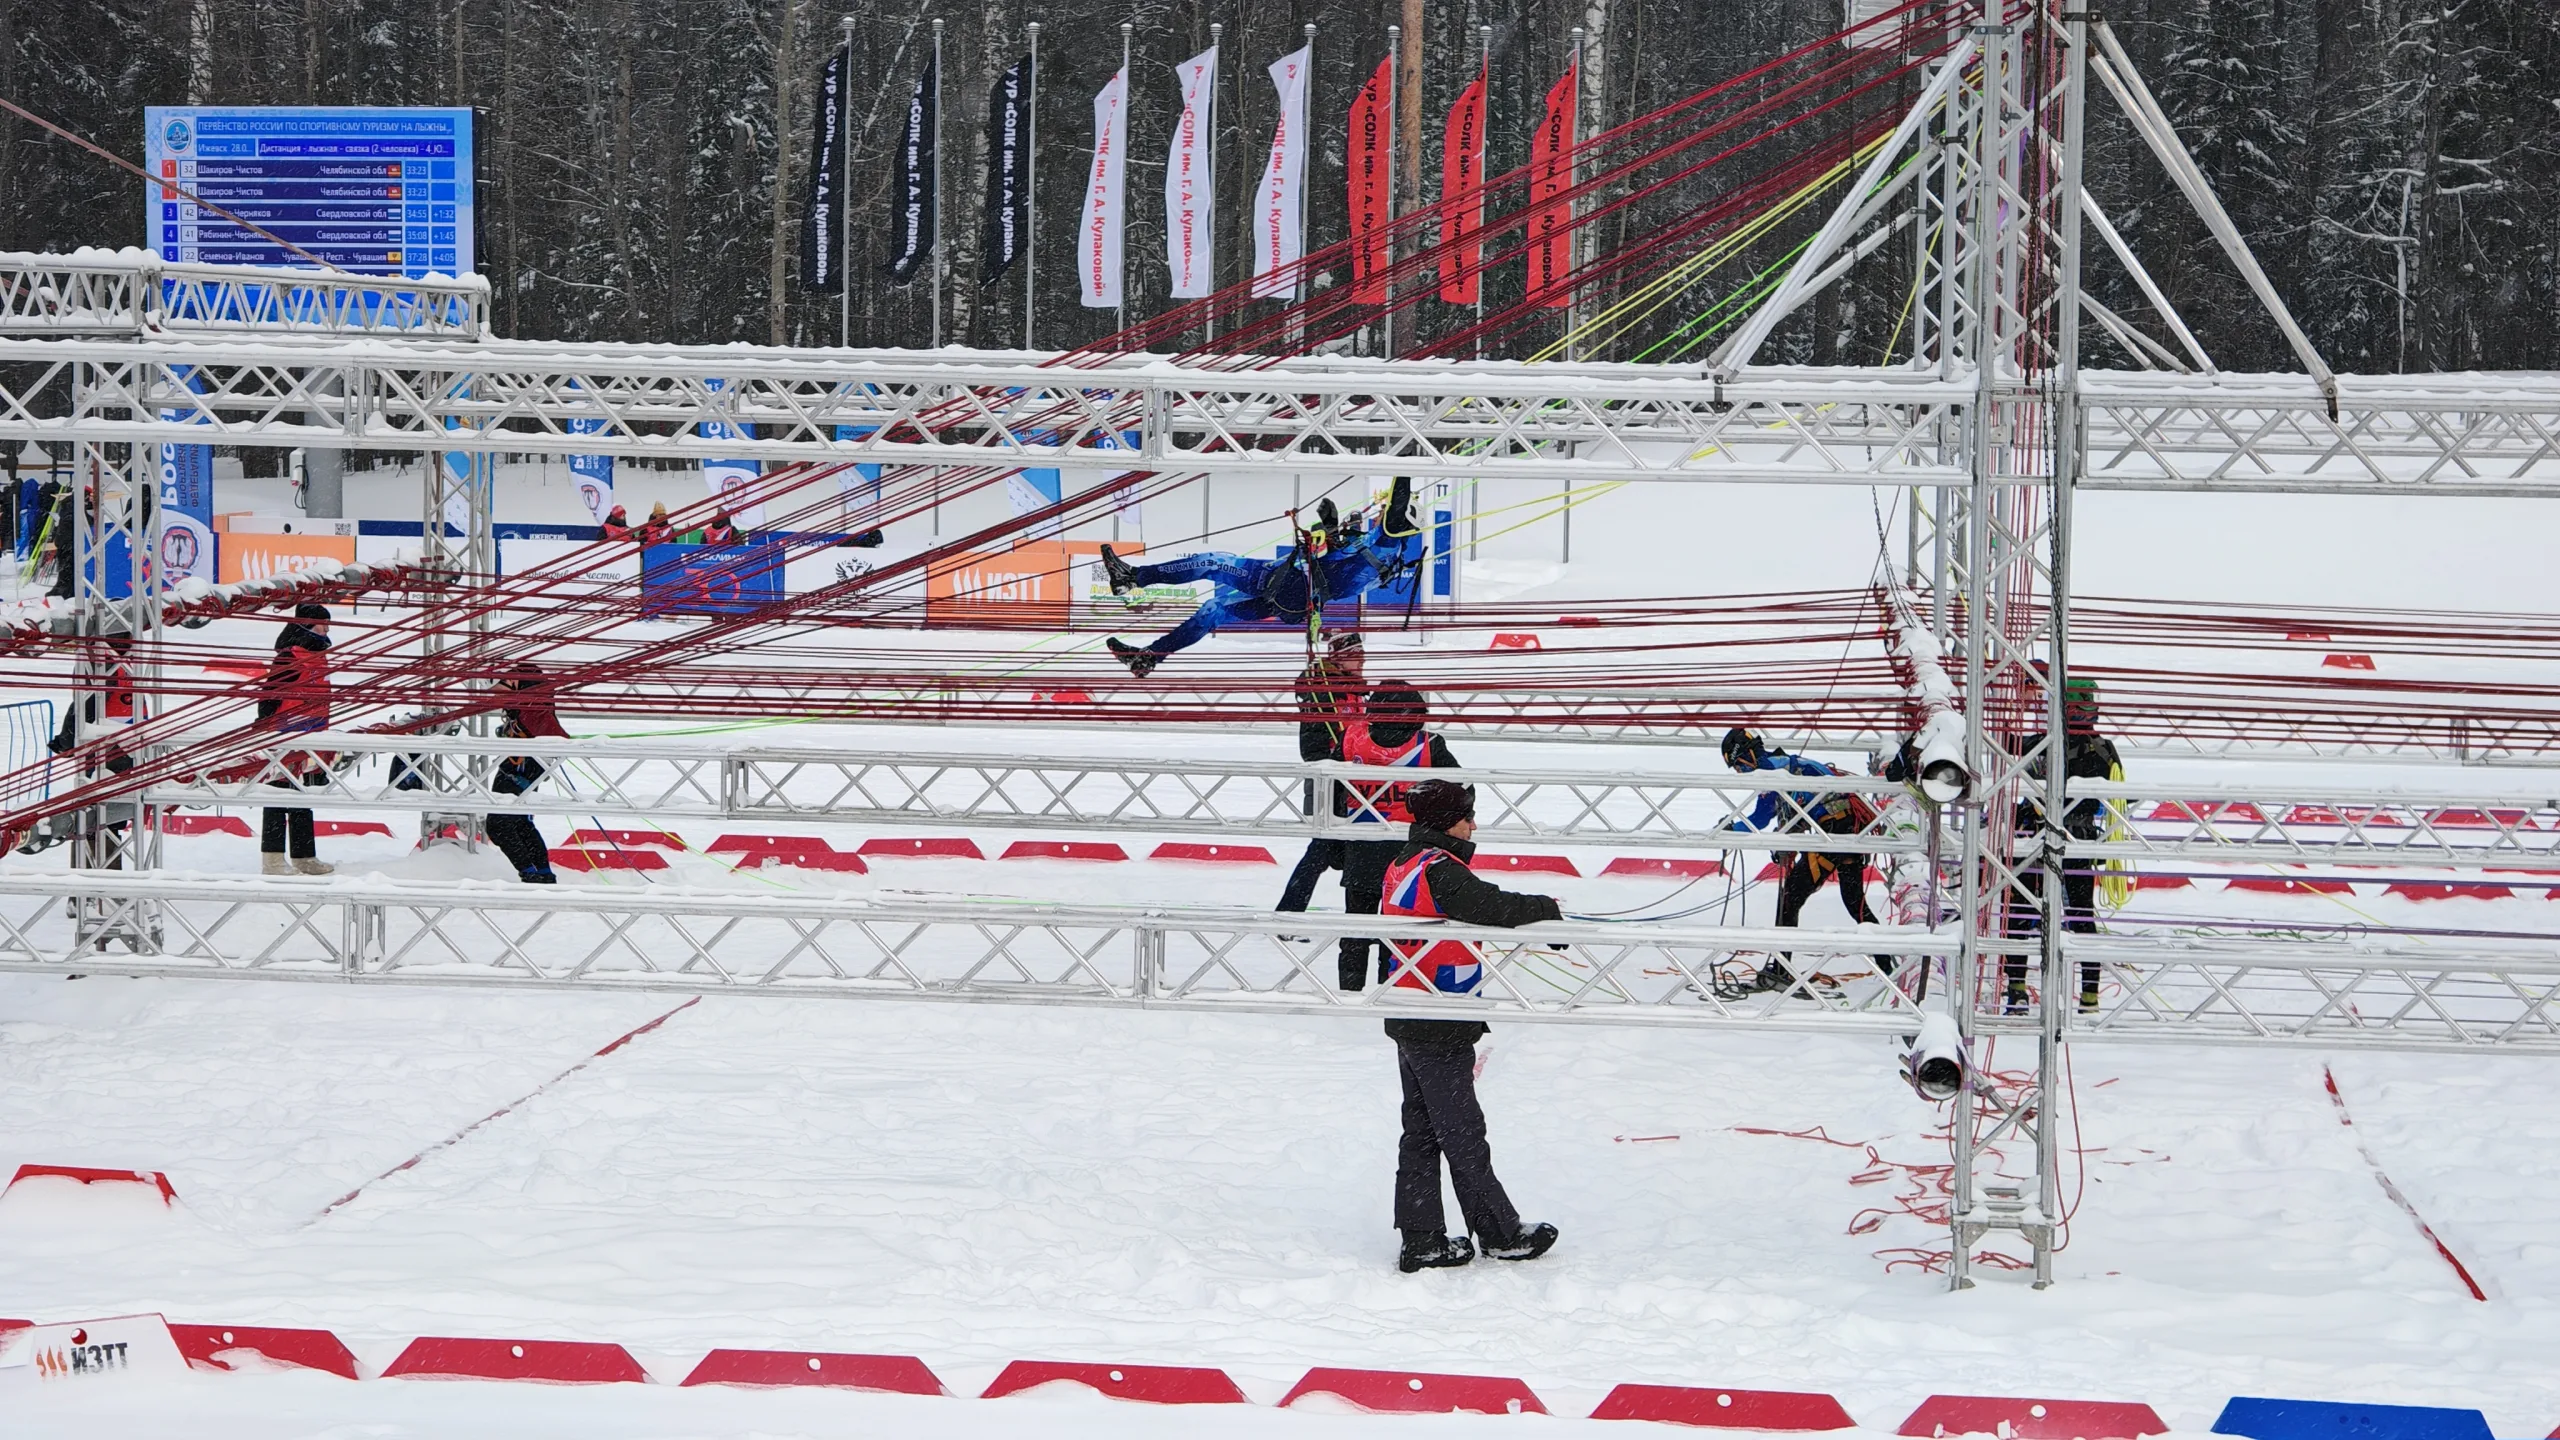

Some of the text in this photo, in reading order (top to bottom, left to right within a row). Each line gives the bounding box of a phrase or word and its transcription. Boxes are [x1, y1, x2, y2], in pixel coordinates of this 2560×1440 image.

[825, 76, 837, 94] УР
[1005, 80, 1018, 98] УР
[250, 121, 284, 131] РОССИИ
[285, 121, 298, 131] ПО
[300, 122, 359, 131] СПОРТИВНОМУ
[363, 122, 399, 131] ТУРИЗМУ
[401, 122, 412, 131] НА
[825, 98, 837, 143] «СОЛК
[910, 98, 923, 143] «СОЛК
[1004, 102, 1018, 146] «СОЛК
[1183, 104, 1195, 149] «СОЛК
[1461, 105, 1473, 150] «СОЛК
[1364, 106, 1377, 151] «СОЛК
[199, 143, 228, 153] Ижевск
[259, 143, 300, 154] Дистанция
[308, 145, 338, 153] лыжная
[345, 145, 369, 153] связка
[371, 143, 379, 154] (2
[380, 143, 418, 155] человека)
[908, 147, 918, 170] им.
[1003, 150, 1014, 173] им.
[1182, 153, 1191, 175] им.
[1273, 152, 1283, 173] им.
[198, 165, 263, 175] Шакиров-Чистов
[320, 165, 370, 175] Челябинской
[372, 165, 386, 174] обл
[406, 166, 426, 174] 33:23
[1096, 160, 1106, 181] им.
[1364, 156, 1373, 178] им.
[819, 173, 830, 182] Г.
[909, 173, 920, 183] Г.
[1003, 177, 1013, 186] Г.
[1182, 180, 1192, 188] Г.
[1272, 178, 1284, 186] Г.
[198, 187, 263, 197] Шакиров-Чистов
[320, 187, 370, 197] Челябинской
[372, 187, 386, 196] обл
[406, 188, 427, 196] 33:23
[817, 185, 829, 200] А.
[909, 186, 921, 200] А.
[1095, 186, 1106, 194] Г.
[1365, 182, 1373, 190] Г.
[1546, 183, 1556, 192] Г.
[1003, 190, 1013, 204] А.
[1182, 192, 1193, 205] А.
[1272, 190, 1282, 204] А.
[1364, 195, 1373, 209] А.
[1094, 199, 1105, 212] А.
[168, 208, 173, 216] 3
[316, 209, 370, 219] Свердловской
[372, 209, 386, 218] обл
[434, 210, 454, 218] +1:32
[168, 230, 173, 238] 4
[185, 230, 194, 238] 41
[316, 231, 370, 240] Свердловской
[372, 231, 386, 239] обл
[407, 231, 427, 239] 35:08
[434, 231, 454, 239] +1:45
[199, 252, 264, 261] Семенов-Иванов
[326, 252, 346, 262] Респ.
[353, 252, 386, 263] Чувашия
[407, 253, 427, 261] 37:28
[434, 253, 454, 261] +4:05
[1091, 217, 1106, 297] Кулаковой»
[987, 572, 1043, 603] ИЗТТ
[71, 1342, 128, 1376] ИЗТТ
